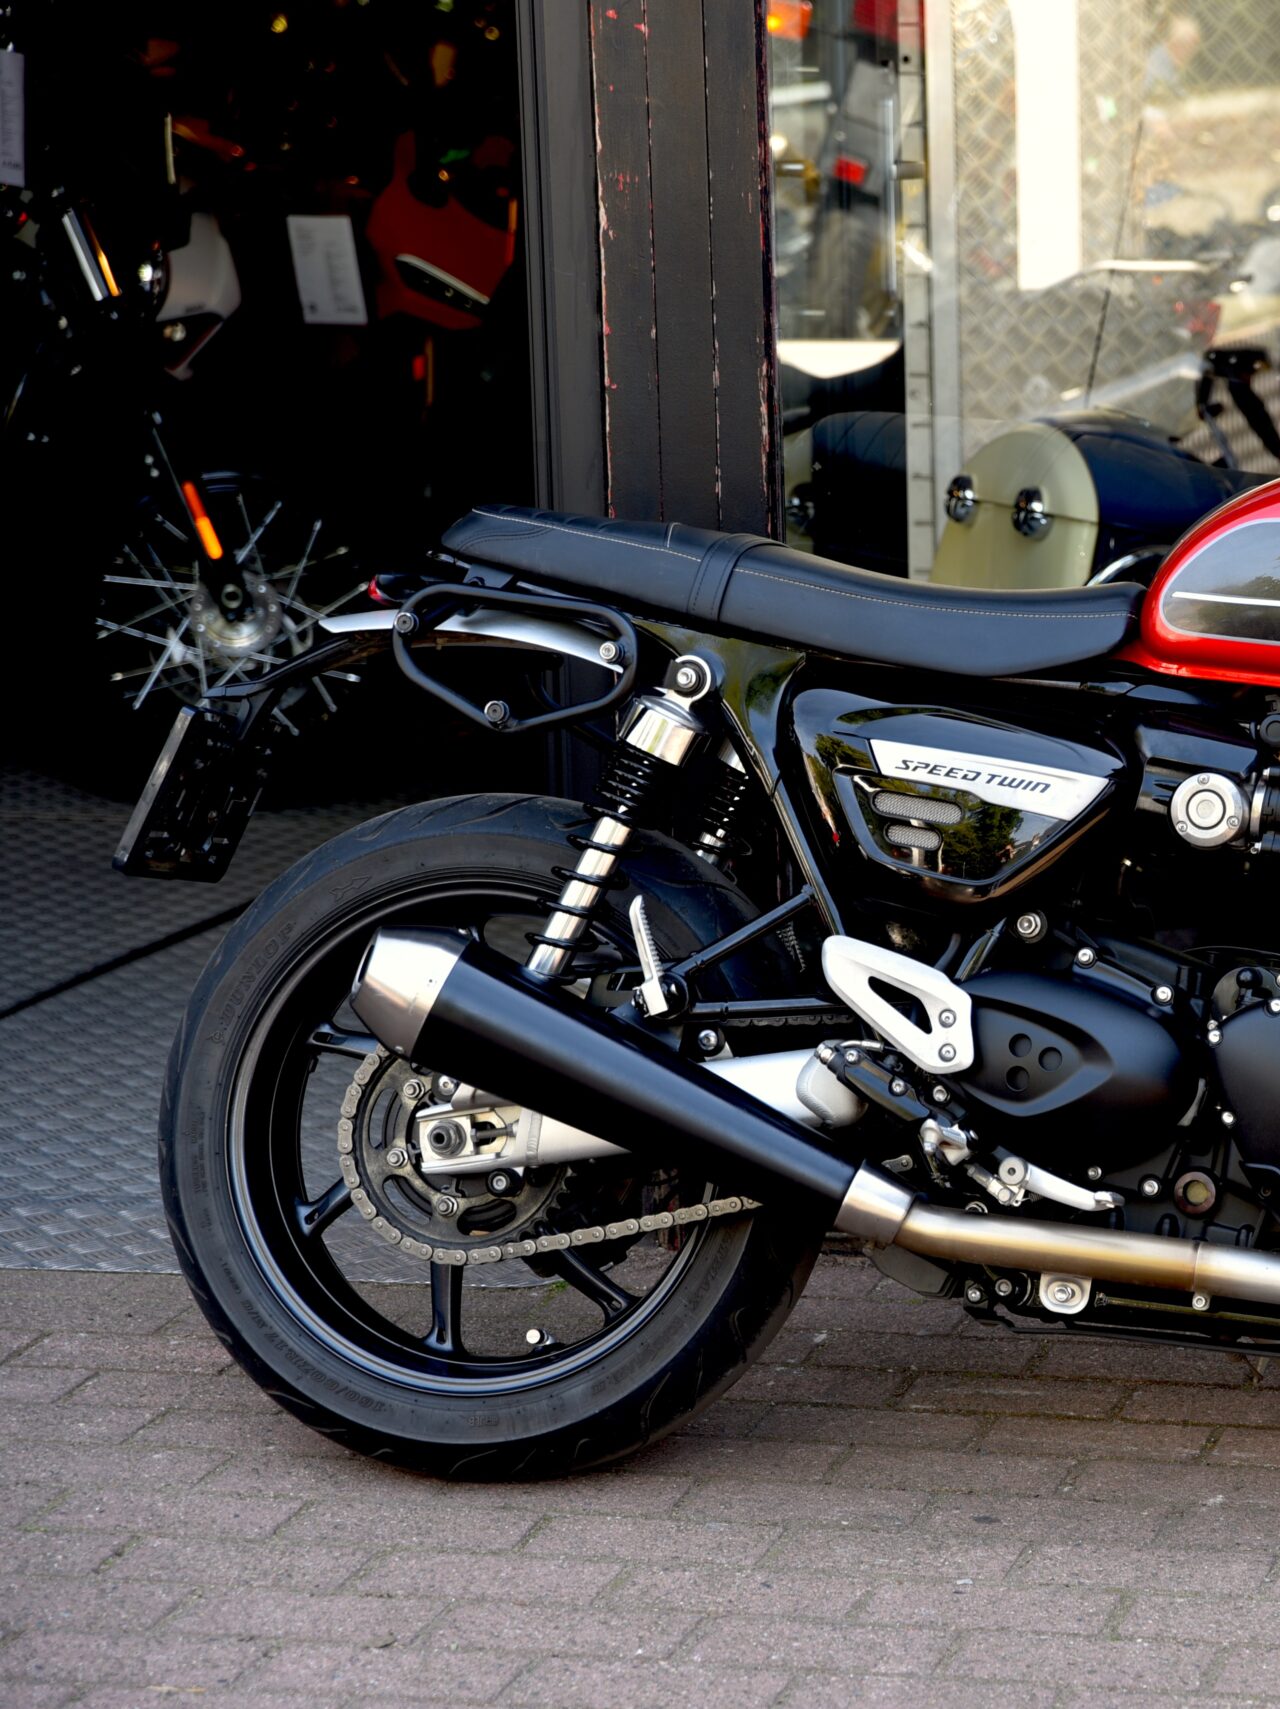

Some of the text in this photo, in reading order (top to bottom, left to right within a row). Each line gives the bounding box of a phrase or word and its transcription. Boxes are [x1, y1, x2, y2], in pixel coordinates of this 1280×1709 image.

[895, 759, 1052, 794] SPEED TWIN
[218, 922, 295, 1023] DUNLOP
